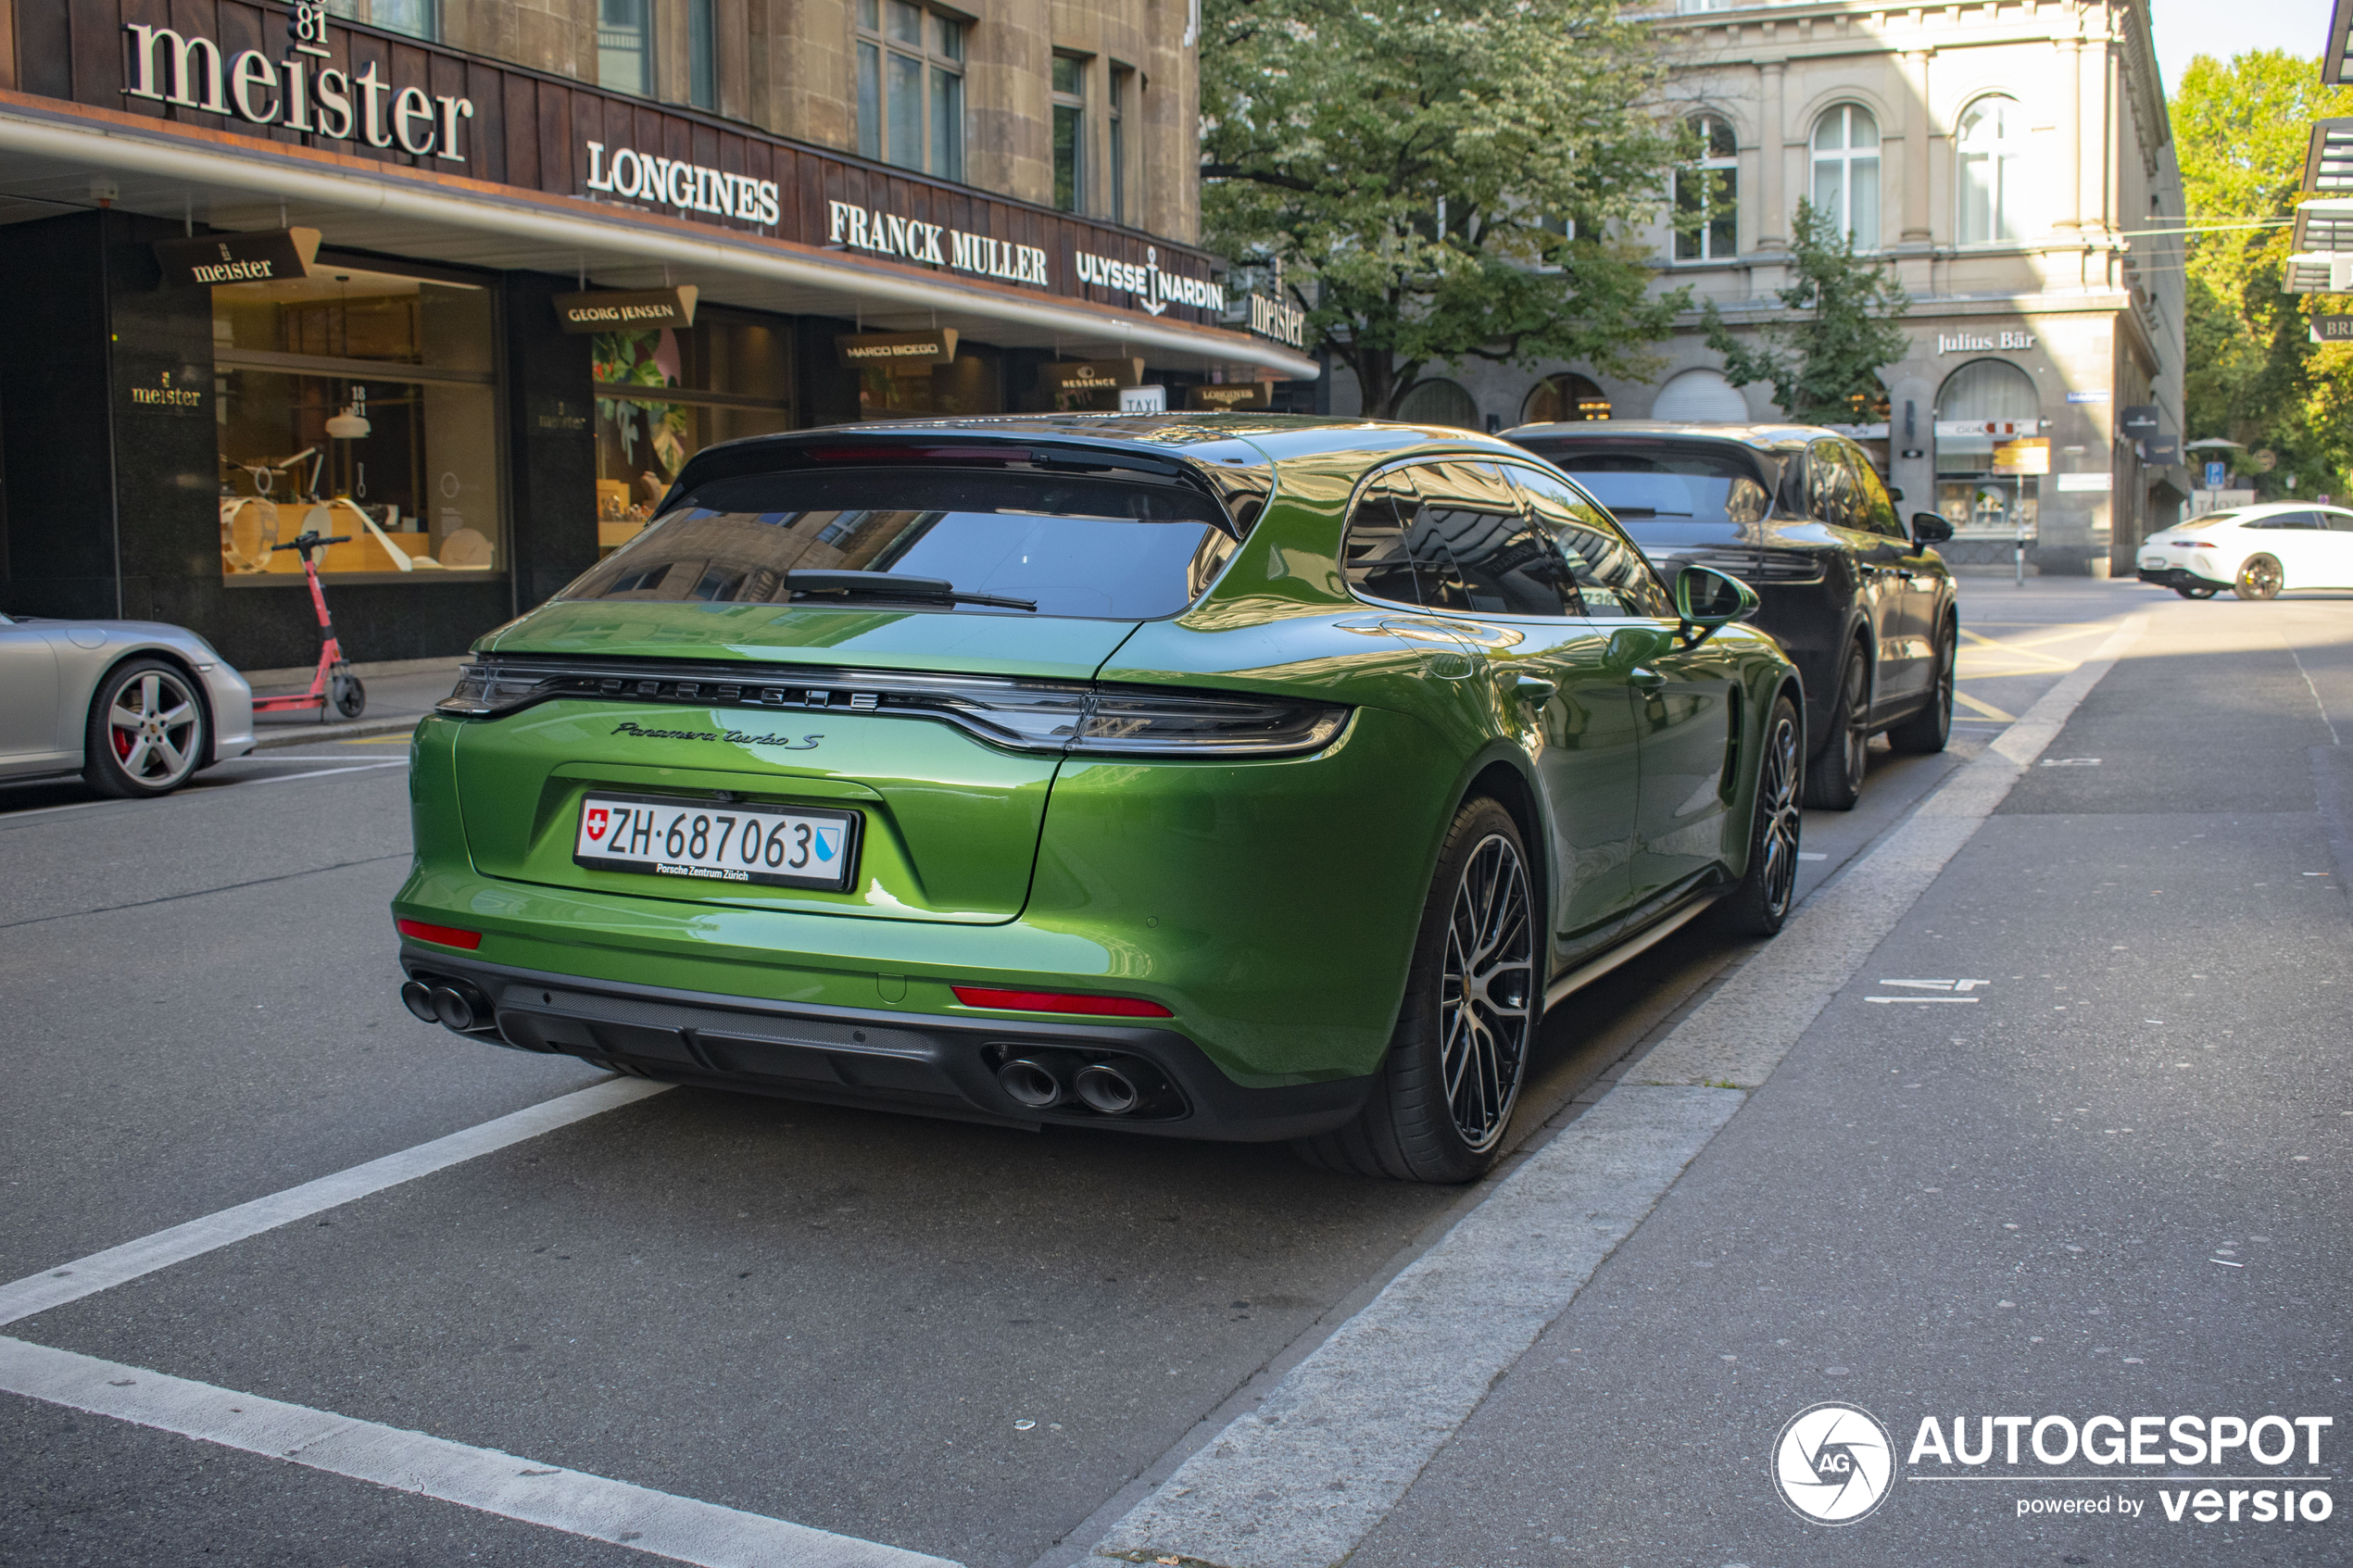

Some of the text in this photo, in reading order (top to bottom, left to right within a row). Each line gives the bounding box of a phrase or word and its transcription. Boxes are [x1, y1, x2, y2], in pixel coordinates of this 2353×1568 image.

[295, 6, 329, 44] 81
[127, 23, 473, 161] meister
[586, 140, 780, 226] LONGINES
[829, 199, 1049, 286] FRANCK MULLER
[191, 258, 273, 282] meister
[1076, 250, 1148, 295] ULYSSE
[1158, 270, 1224, 311] NARDIN
[568, 304, 674, 322] GEORG JENSEN
[1251, 293, 1304, 347] meister
[847, 345, 892, 358] MARCO
[1938, 331, 2036, 356] Julius Bär
[351, 385, 366, 401] 18
[1062, 378, 1116, 388] RESSENCE
[132, 387, 201, 407] meister
[1126, 399, 1158, 412] TAXI
[610, 721, 825, 750] Panamera turbo S
[656, 863, 749, 881] Porsche Zentrum Zürich
